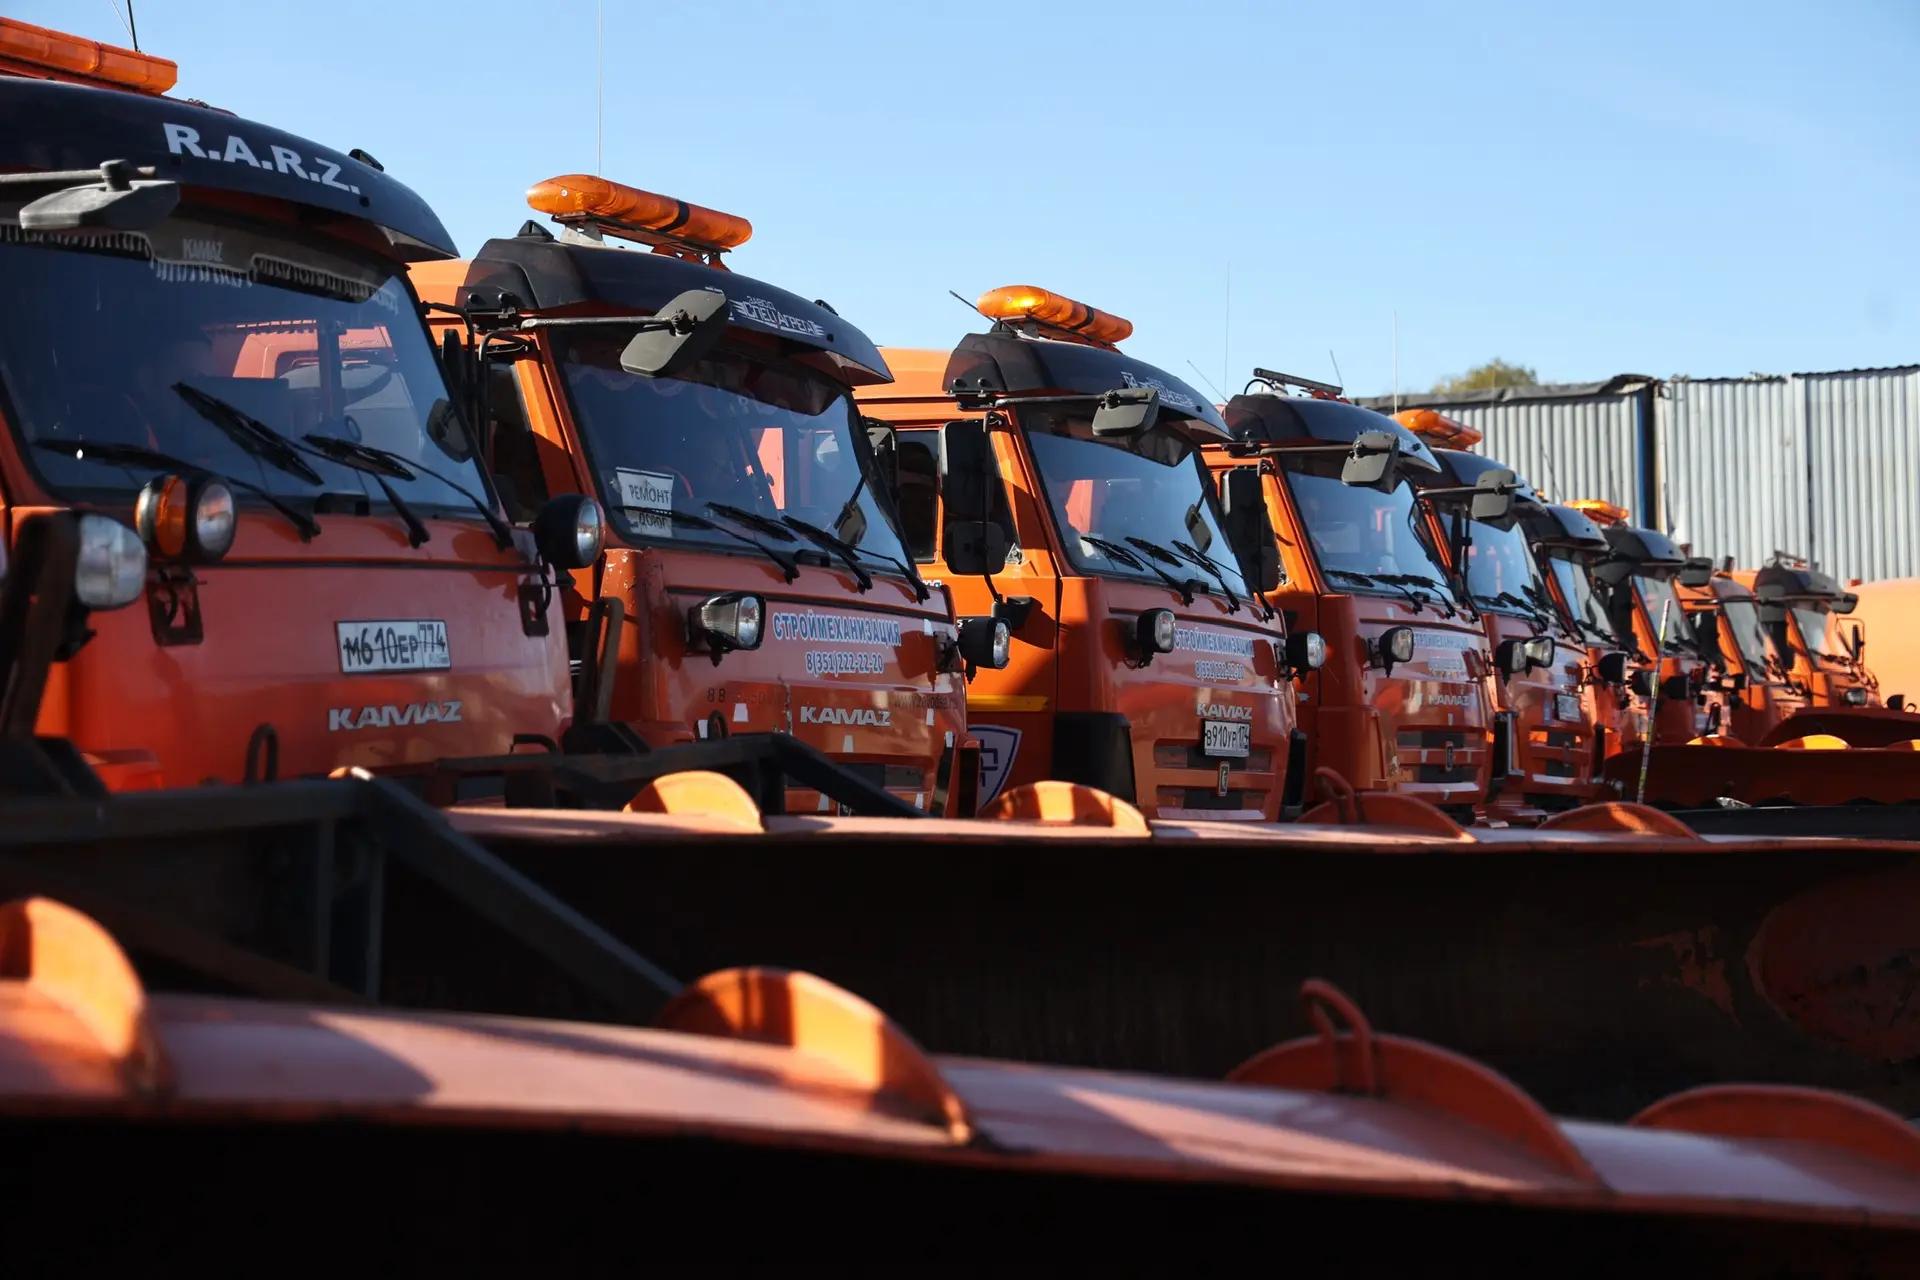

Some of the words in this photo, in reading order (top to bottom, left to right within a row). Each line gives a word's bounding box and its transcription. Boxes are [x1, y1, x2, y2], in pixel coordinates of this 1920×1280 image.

[163, 122, 361, 195] R.A.R.Z.
[628, 484, 671, 504] РЕМОНТ
[773, 609, 902, 648] СТРОЙМЕХАНИЗАЦИЯ
[806, 650, 884, 677] 8(351)222-22-20
[329, 701, 463, 731] KAMAZ
[800, 706, 892, 727] KAMAZ
[1196, 703, 1252, 720] KAMAZ
